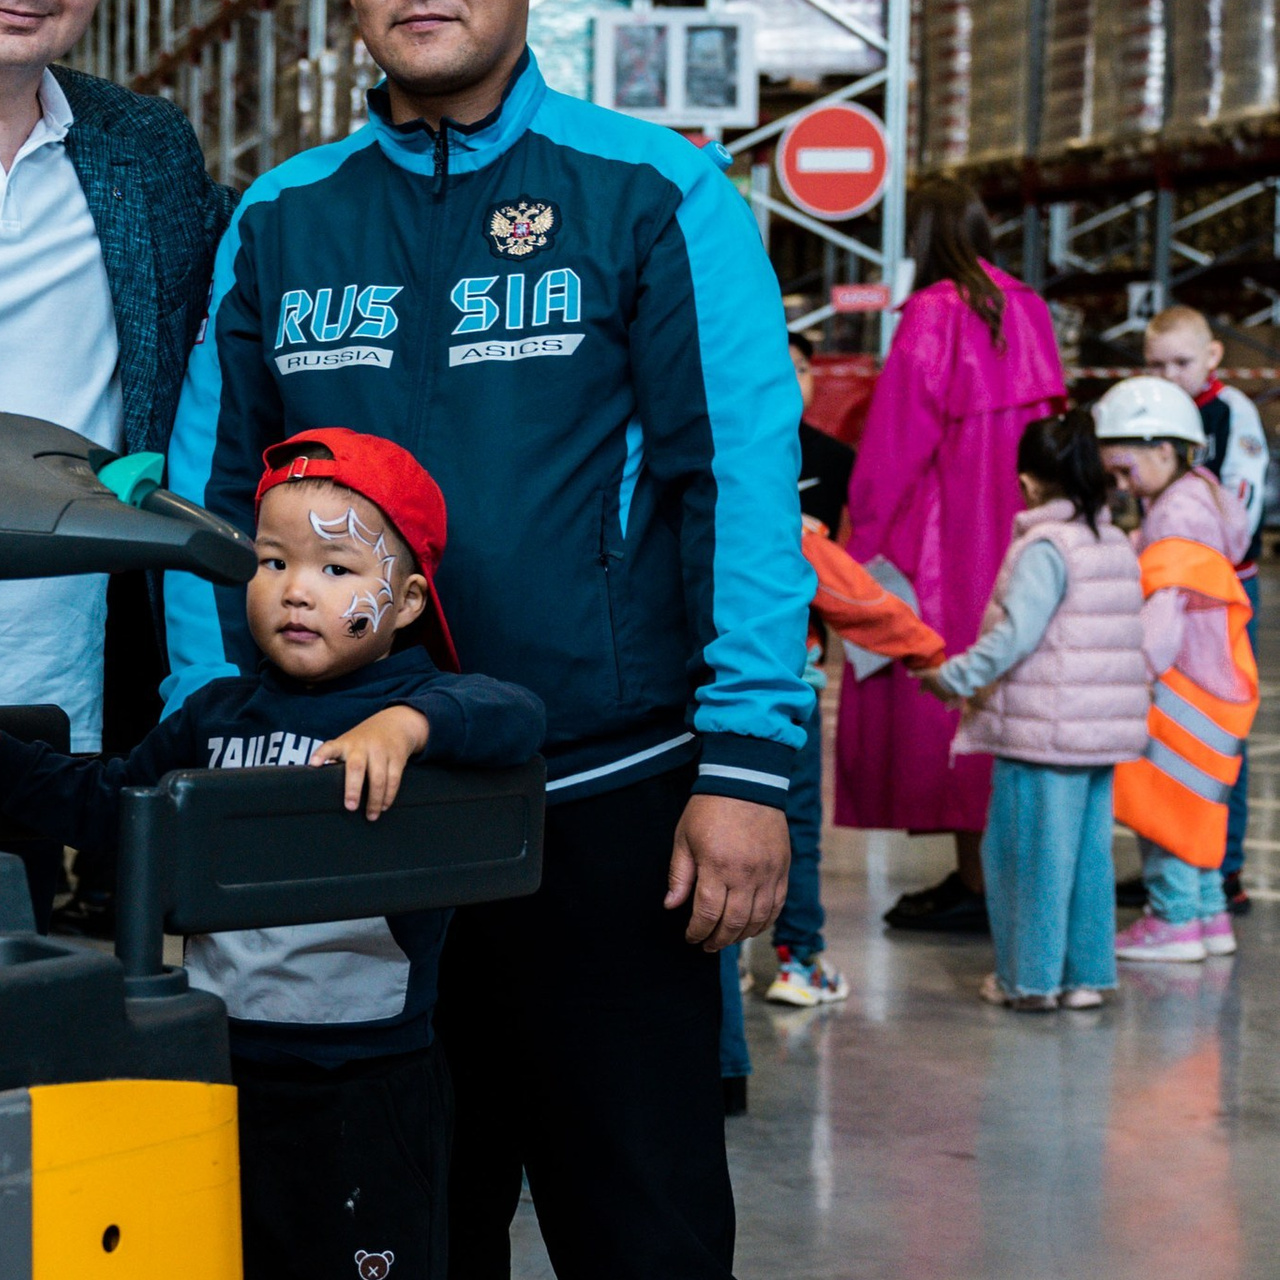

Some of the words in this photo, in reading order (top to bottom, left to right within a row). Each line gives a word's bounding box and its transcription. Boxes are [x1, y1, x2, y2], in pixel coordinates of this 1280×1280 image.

[274, 284, 404, 350] RUS
[450, 267, 581, 335] SIA
[287, 349, 381, 369] RUSSIA
[461, 338, 564, 361] ASICS
